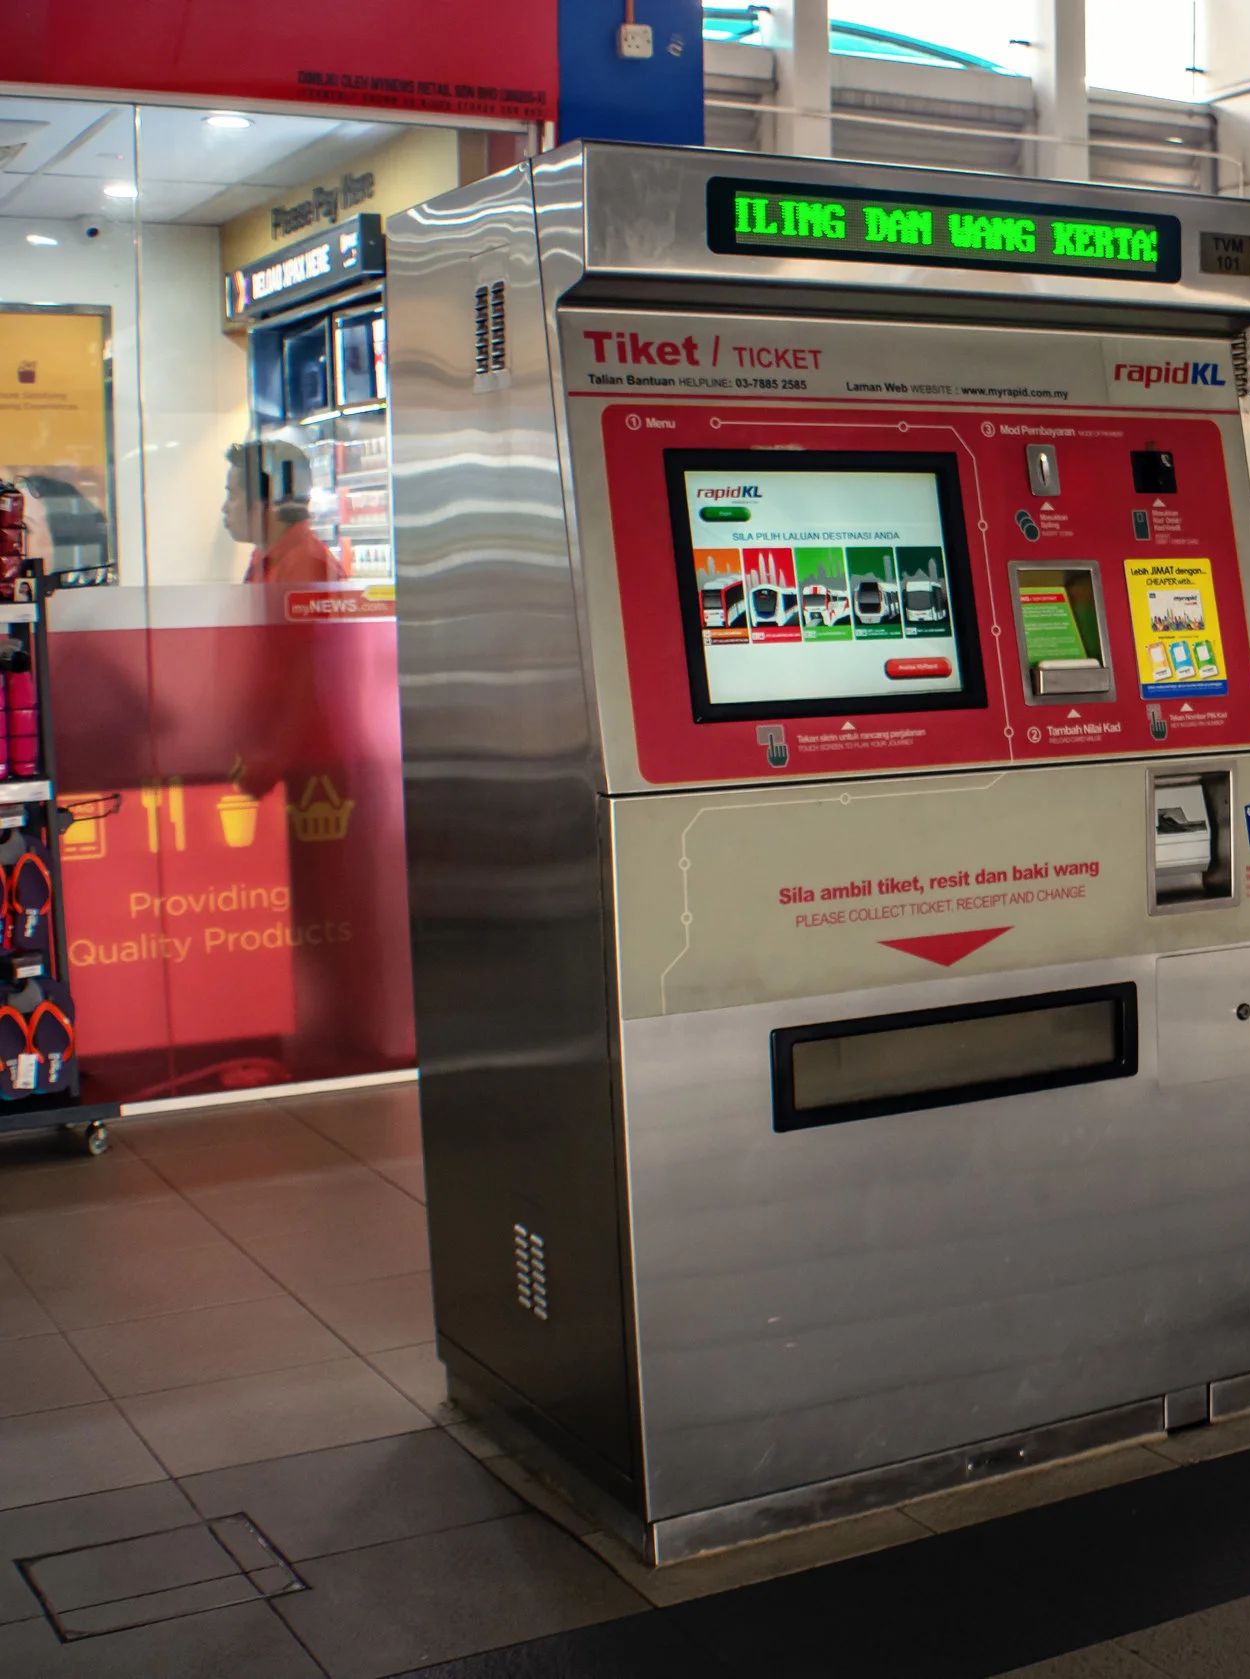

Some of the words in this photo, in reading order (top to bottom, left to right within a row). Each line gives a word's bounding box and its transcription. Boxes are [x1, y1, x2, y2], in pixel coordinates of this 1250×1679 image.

[313, 186, 338, 223] Pay
[1213, 236, 1244, 254] TVM
[306, 243, 331, 279] HERE
[1215, 255, 1241, 272] 101
[583, 330, 701, 367] Tiket
[732, 346, 823, 370] TICKET
[588, 373, 623, 386] Talian
[626, 373, 676, 387] Bantuan
[735, 377, 778, 390] 03-7885
[781, 378, 807, 391] 2585
[1114, 361, 1226, 389] rapidKL
[846, 381, 882, 394] Laman
[884, 382, 908, 394] Web
[961, 386, 1068, 401] www.myrapid.com.my
[646, 417, 676, 430] Menu
[1000, 424, 1020, 436] Mod
[1021, 424, 1076, 438] Pembayaran
[696, 486, 763, 501] rapidKL
[732, 532, 754, 541] SILA
[756, 531, 781, 541] PILIH
[783, 531, 820, 541] LALUAN
[822, 531, 872, 541] DESTINASI
[874, 531, 900, 540] ANDA
[1131, 568, 1149, 576] Lebih
[1151, 566, 1174, 576] JIMAT
[1146, 578, 1177, 586] CHEAPER
[1046, 724, 1083, 737] Tambah
[1083, 723, 1102, 735] Nilai
[1103, 721, 1121, 733] Kad
[778, 886, 815, 905] Sila
[820, 879, 872, 901] ambil
[877, 874, 925, 895] tiket,
[929, 870, 970, 890] resit
[975, 868, 1008, 885] dan
[1012, 862, 1049, 881] baki
[1053, 860, 1100, 878] wang
[129, 883, 291, 919] Providing
[795, 909, 846, 928] PLEASE
[849, 903, 907, 923] COLLECT
[910, 899, 954, 916] TICKET,
[956, 892, 1008, 912] RECEIPT
[1009, 890, 1035, 905] AND
[1036, 885, 1086, 902] CHANGE
[68, 932, 192, 968] Quality
[204, 920, 354, 955] Products
